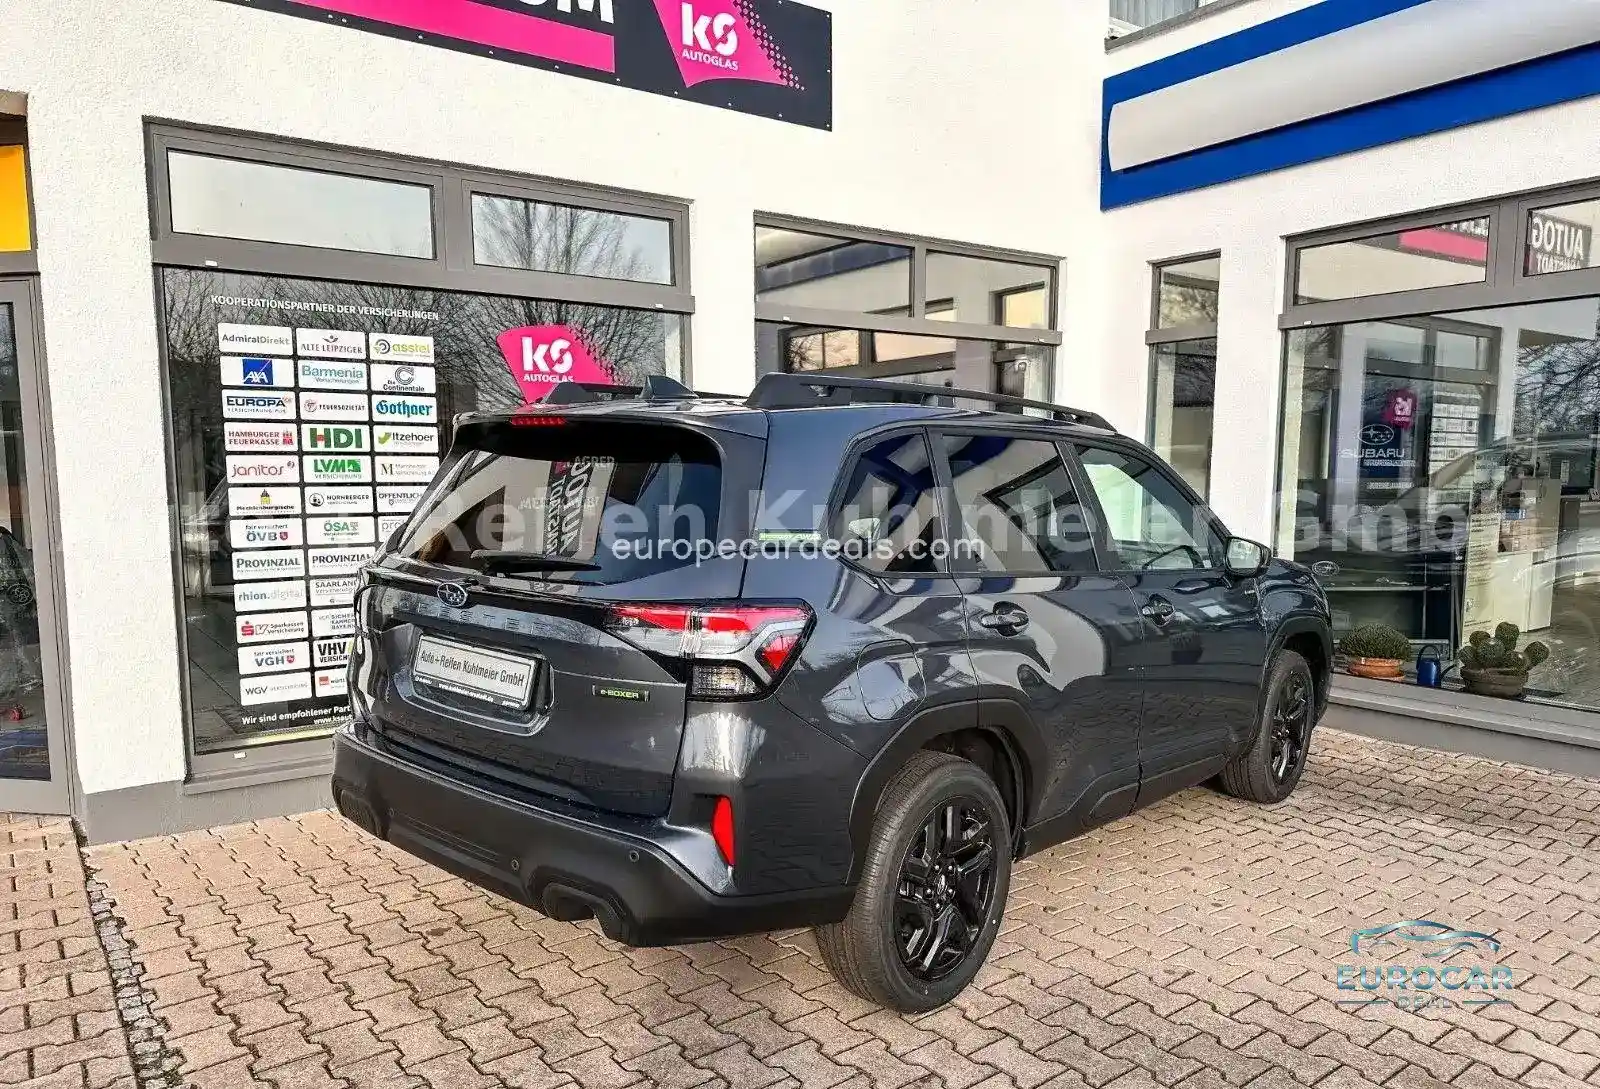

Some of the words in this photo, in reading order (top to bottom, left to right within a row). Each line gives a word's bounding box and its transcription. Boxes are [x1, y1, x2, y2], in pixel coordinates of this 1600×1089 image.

[682, 48, 739, 71] AUTOGLAS
[210, 294, 335, 313] KOOPERATIONSPARTNER
[336, 304, 356, 314] DER
[357, 306, 439, 321] VERSICHERUNGEN
[222, 333, 291, 346] AdmiralDirekt
[300, 343, 320, 352] ALTE
[322, 344, 363, 354] LEIPZIGER
[241, 371, 269, 384] AXA
[302, 364, 364, 379] Barmenia
[383, 383, 425, 392] Continentale
[226, 395, 287, 408] EUROPA
[376, 399, 433, 418] Gothaer
[228, 430, 280, 438] HAMBURGER
[309, 427, 363, 449] HDI
[392, 432, 434, 442] Itzehoer
[228, 438, 280, 446] FEUERKASSE
[1338, 448, 1405, 459] SUBARU
[231, 464, 284, 478] janitos
[313, 459, 346, 473] LVM
[323, 519, 350, 532] ÖSA
[246, 530, 277, 542] ÖVB
[236, 558, 301, 569] PROVINZIAL
[238, 589, 304, 602] rhion.digital
[317, 641, 347, 656] VHV
[255, 656, 285, 667] VGH
[319, 655, 349, 663] VERSICH
[500, 669, 525, 687] GmbH
[245, 686, 268, 695] WGV
[241, 716, 258, 725] Wir
[259, 713, 277, 723] sind
[278, 707, 332, 721] empfohlener
